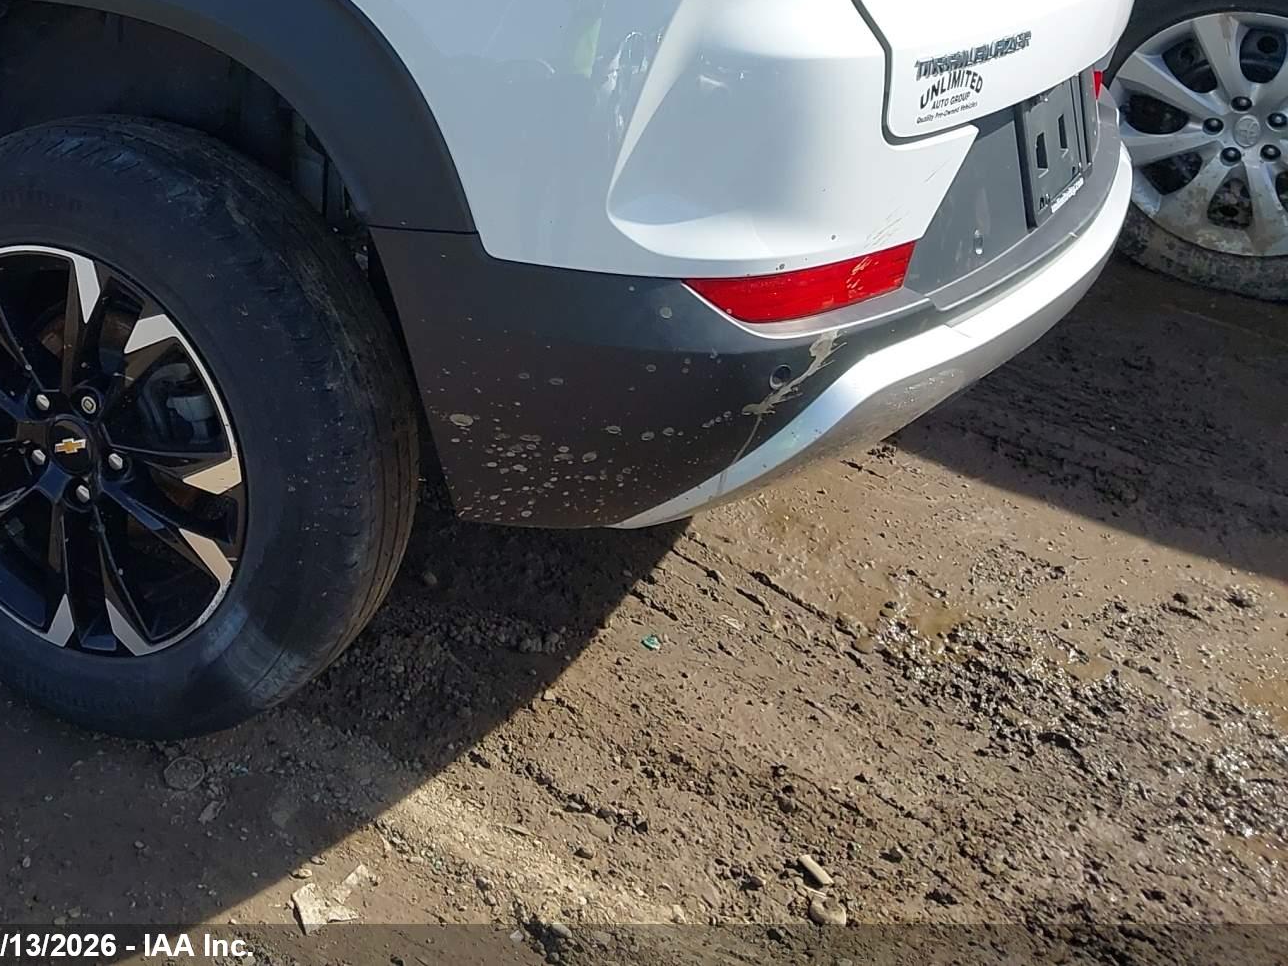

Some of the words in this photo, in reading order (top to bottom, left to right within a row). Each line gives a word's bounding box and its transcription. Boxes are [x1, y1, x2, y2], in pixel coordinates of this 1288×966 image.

[920, 69, 984, 109] UNLIMITED
[931, 97, 949, 110] AUTO
[950, 91, 971, 106] GROUP
[916, 113, 934, 125] Quality
[935, 106, 960, 120] Pre-Owned
[960, 101, 978, 112] Vehicles
